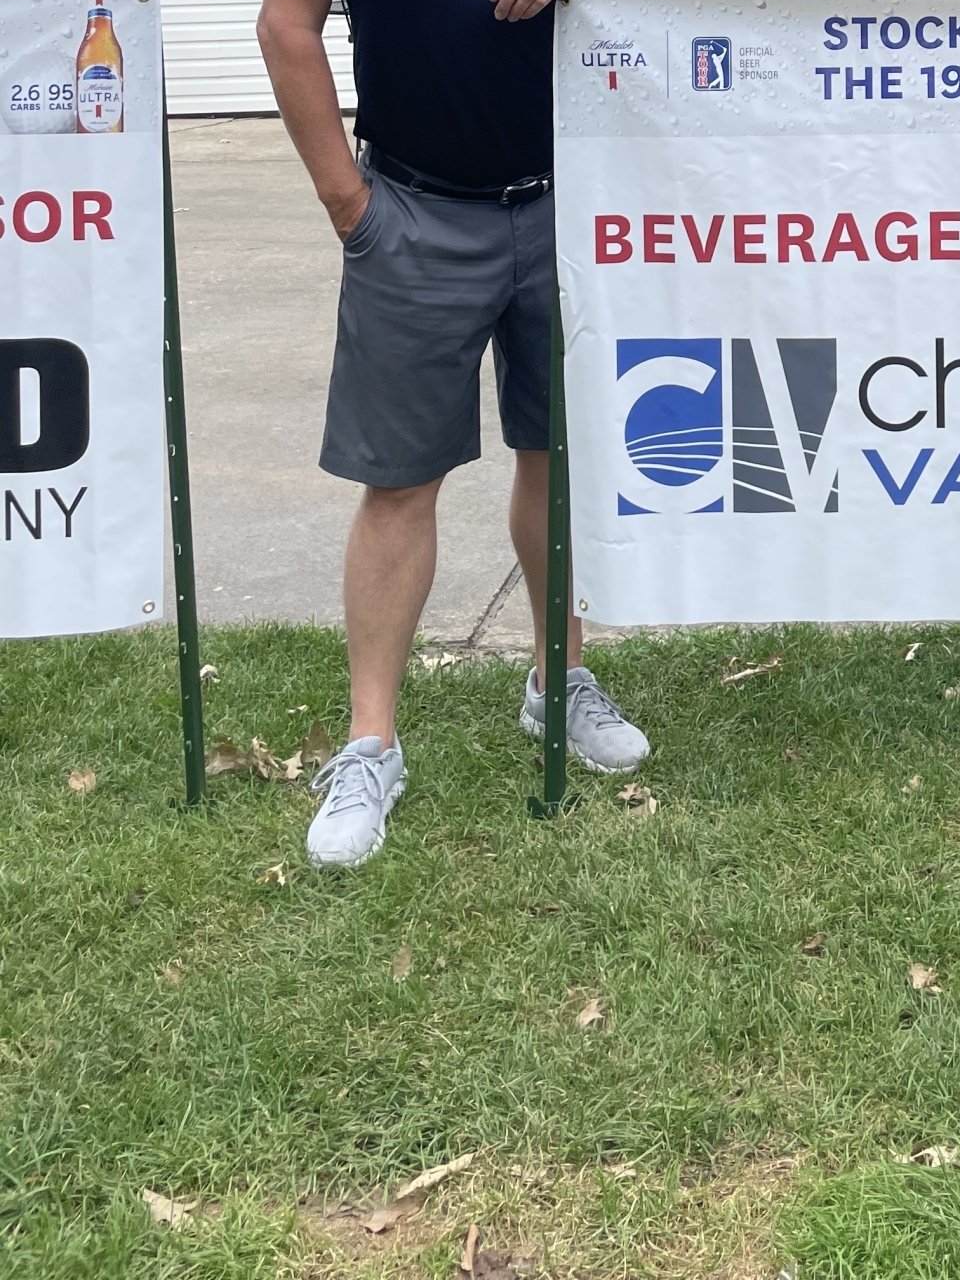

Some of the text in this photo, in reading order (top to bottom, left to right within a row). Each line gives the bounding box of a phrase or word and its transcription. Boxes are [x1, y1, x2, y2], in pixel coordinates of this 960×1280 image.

[589, 39, 634, 50] Michelob
[739, 47, 775, 57] OFFICIAL
[581, 53, 647, 67] ULTRA
[739, 59, 760, 69] BEER
[697, 50, 709, 87] TOUR
[739, 70, 779, 81] SPONSOR
[815, 65, 902, 100] THE
[11, 84, 73, 101] 2.6 95
[80, 92, 120, 102] ULTRA
[10, 103, 41, 111] CARBS
[0, 190, 115, 243] OR
